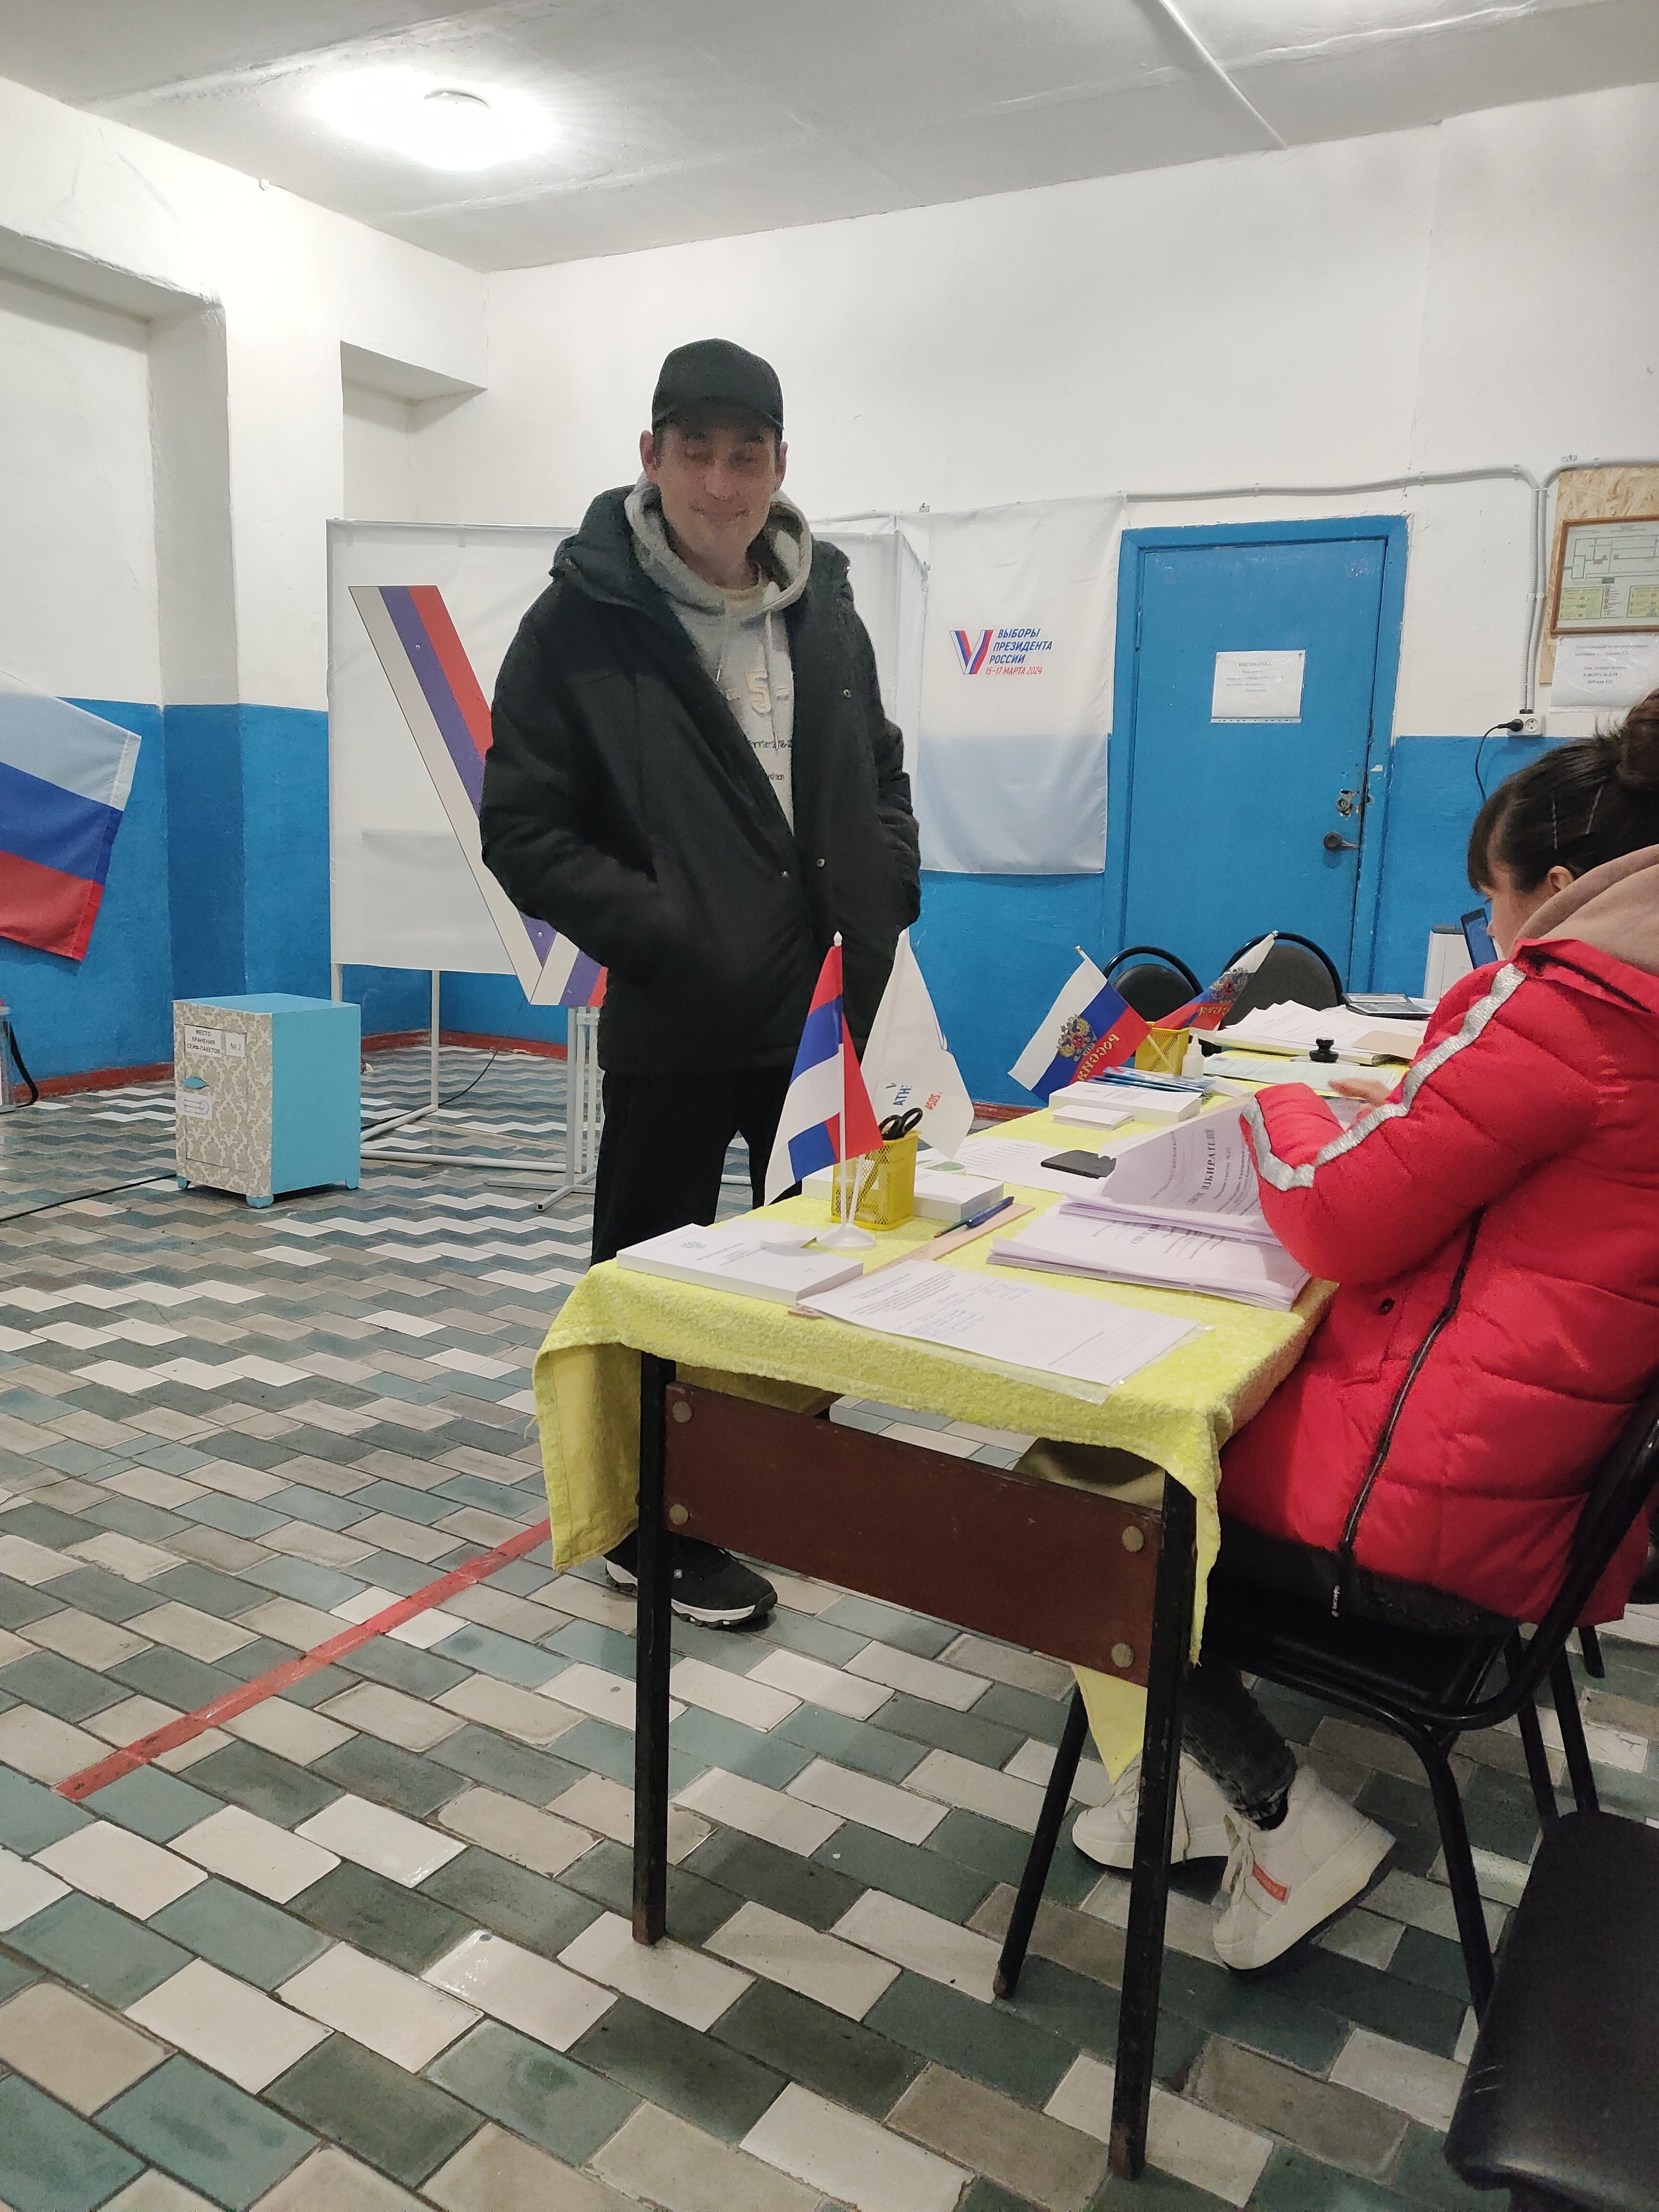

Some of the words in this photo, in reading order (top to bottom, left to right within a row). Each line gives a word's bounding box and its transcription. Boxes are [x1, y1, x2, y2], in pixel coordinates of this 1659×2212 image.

[998, 628, 1041, 638] ВЫБОРЫ
[993, 641, 1053, 652] ПРЕЗИДЕНТА
[989, 654, 1026, 664] РОССИИ
[1003, 667, 1025, 675] МАРТА
[1026, 666, 1043, 674] 2024
[196, 1029, 211, 1037] МЕСТО
[192, 1036, 215, 1045] ХРАНЕНИЯ
[187, 1043, 220, 1054] СЕЙФ-ПАКЕТОВ
